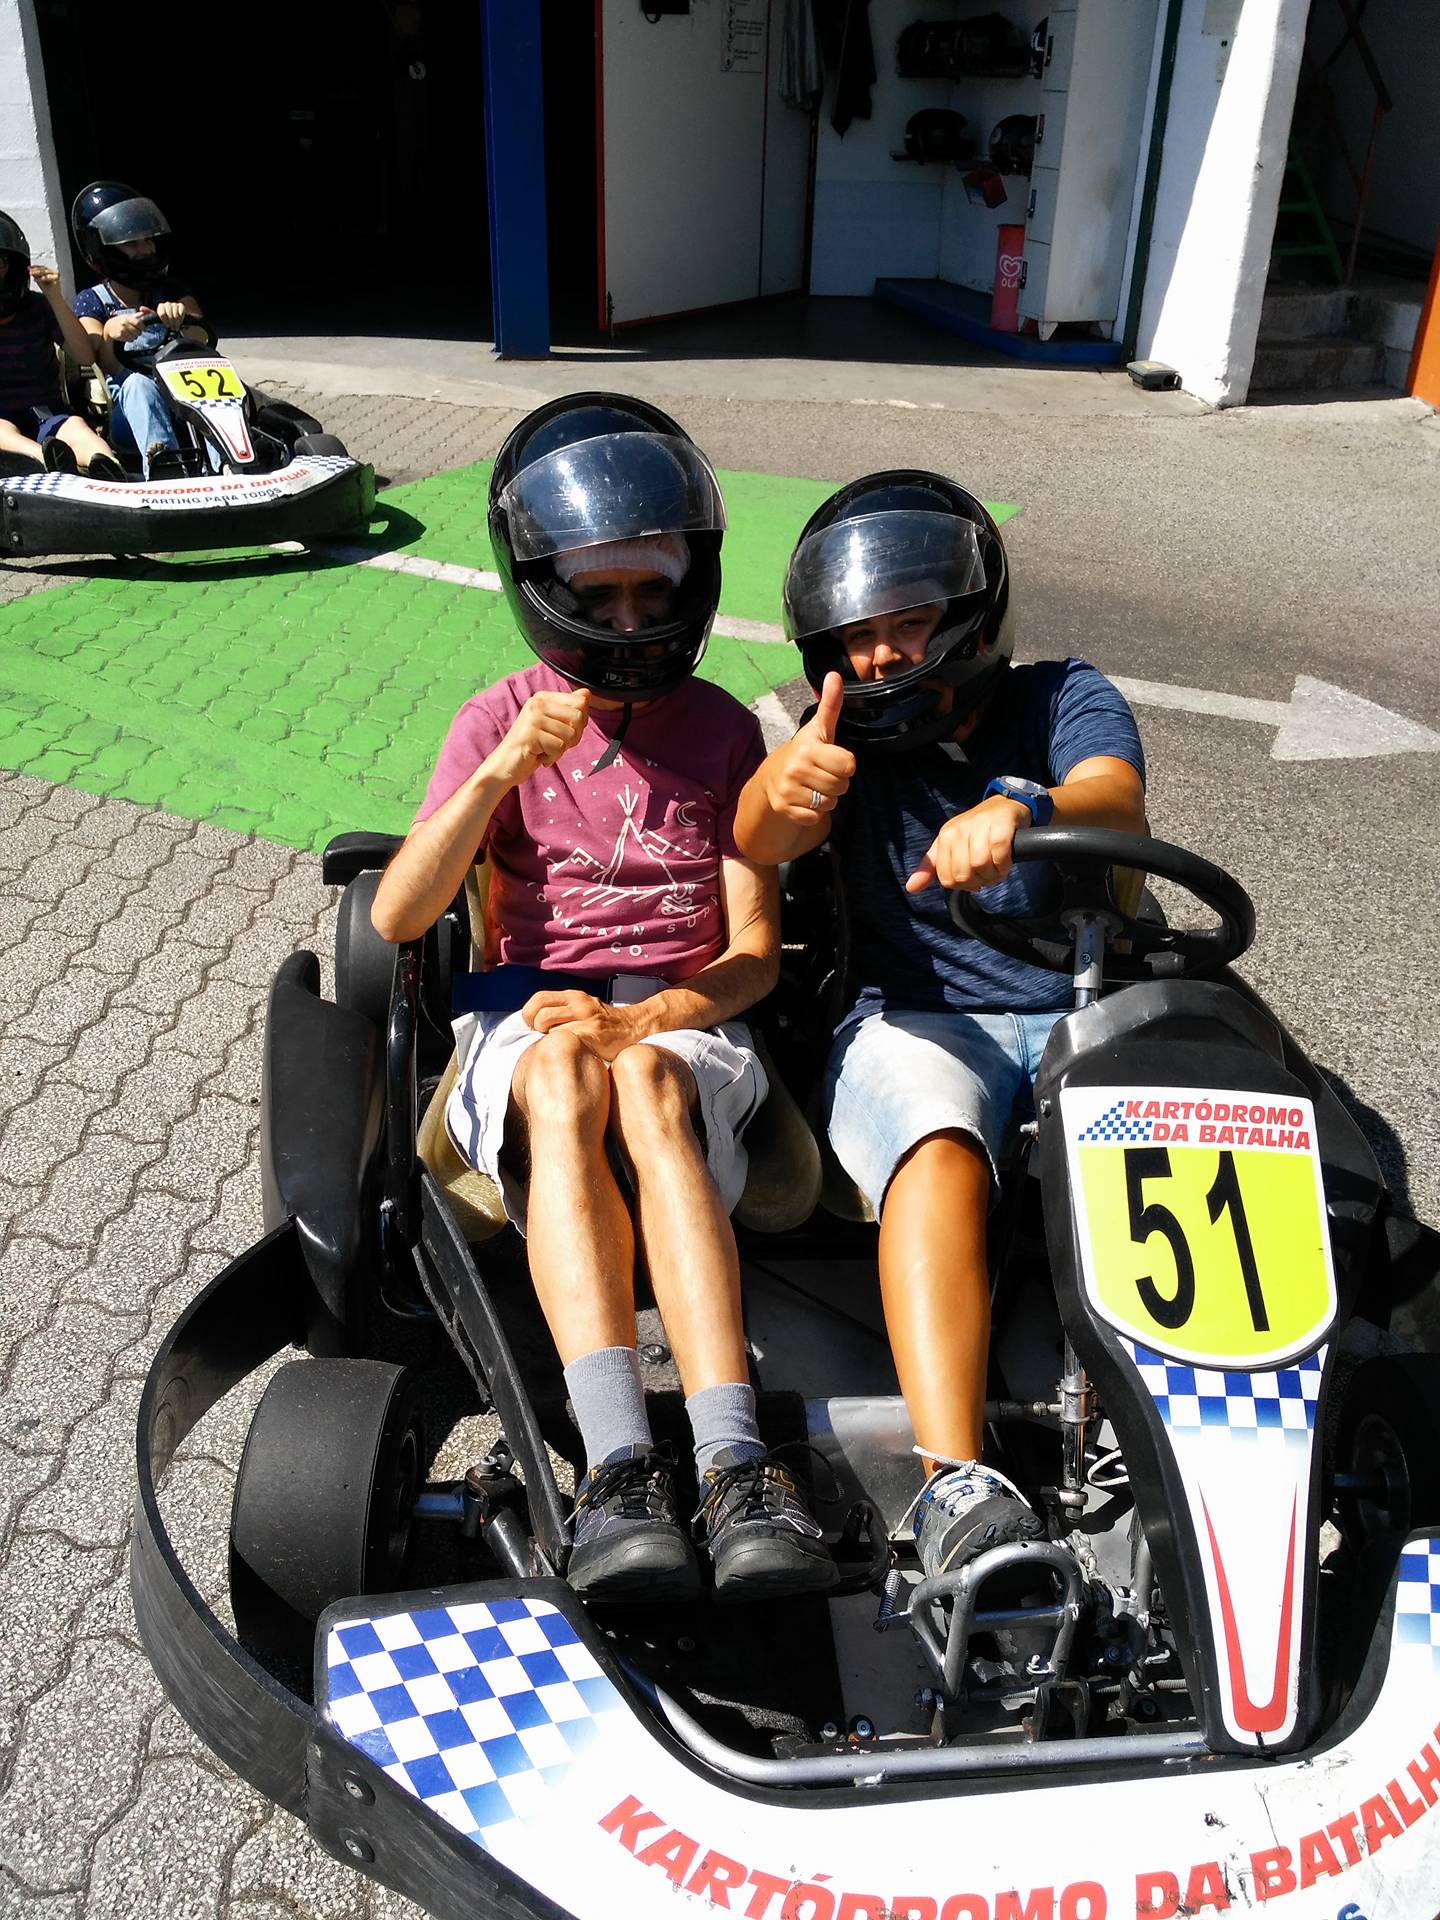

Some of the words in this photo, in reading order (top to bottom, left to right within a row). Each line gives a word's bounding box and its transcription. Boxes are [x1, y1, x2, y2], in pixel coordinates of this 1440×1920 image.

[179, 369, 234, 398] 52
[220, 483, 245, 491] DA
[251, 468, 311, 488] BATALHA
[141, 496, 200, 505] KARTING
[205, 494, 239, 503] PARA
[244, 487, 283, 498] TODOS
[1124, 1098, 1304, 1127] KARTÓDROMO
[1152, 1123, 1189, 1142] DA
[1198, 1124, 1311, 1150] BATALHA
[1123, 1147, 1270, 1332] 51
[1135, 1861, 1231, 1920] DA
[1249, 1722, 1440, 1902] BATALH
